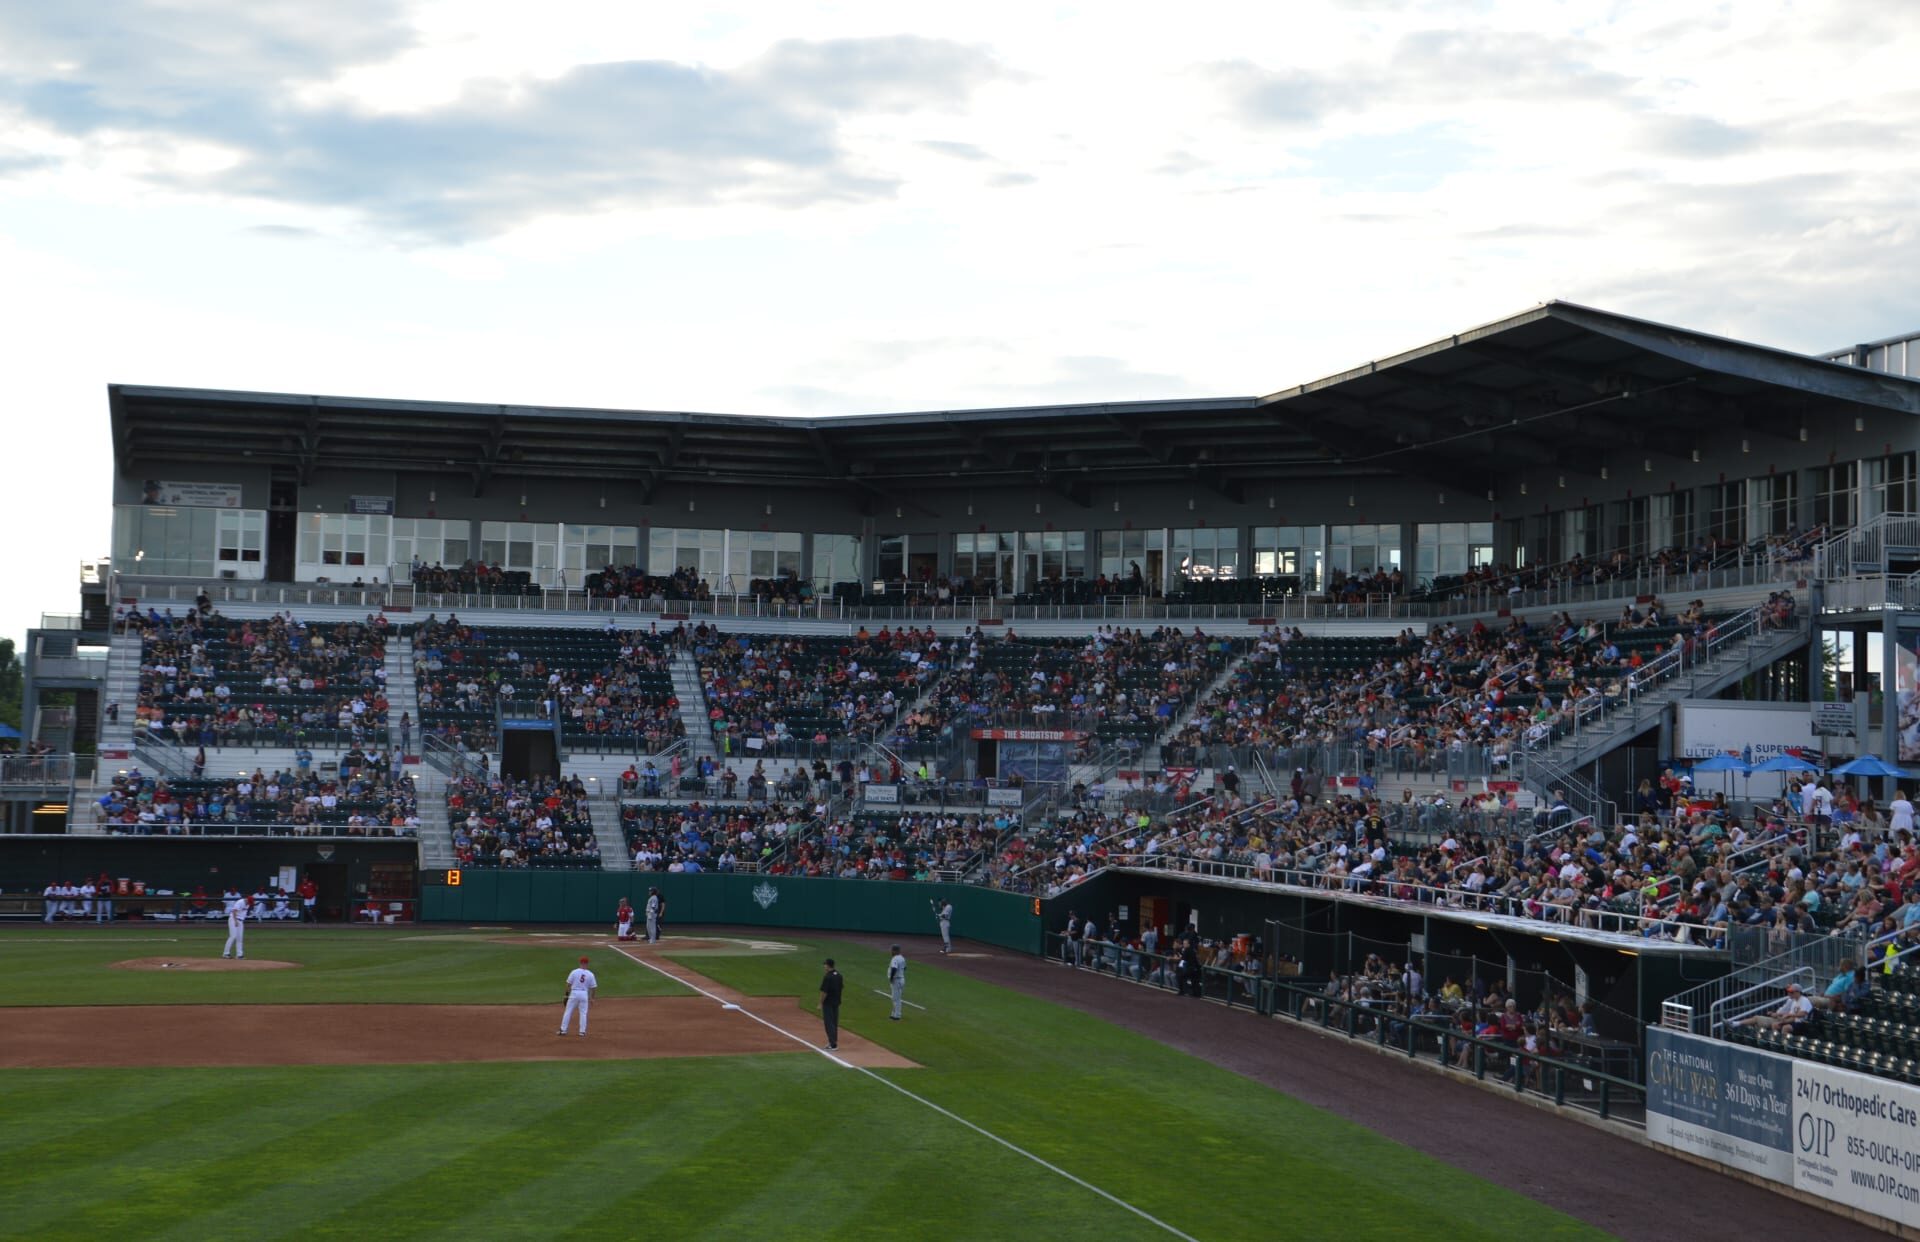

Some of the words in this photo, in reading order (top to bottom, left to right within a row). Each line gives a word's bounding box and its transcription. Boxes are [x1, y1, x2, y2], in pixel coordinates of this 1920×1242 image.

[1004, 730, 1017, 739] THE
[1020, 730, 1064, 740] SHORTSTOP
[579, 974, 586, 983] 5
[1651, 1050, 1685, 1091] CIVIL
[1690, 1072, 1718, 1100] WAR
[1663, 1048, 1677, 1063] THE
[1679, 1052, 1714, 1073] NATIONAL
[1737, 1068, 1747, 1082] We
[1757, 1073, 1773, 1091] Open
[1724, 1081, 1739, 1103] 361
[1740, 1086, 1761, 1112] Days
[1762, 1097, 1769, 1111] a
[1768, 1093, 1788, 1116] Year
[1797, 1077, 1820, 1103] 24/7
[1823, 1084, 1887, 1119] Orthopedic
[1889, 1100, 1917, 1127] Care
[1798, 1112, 1835, 1158] OIP
[1850, 1168, 1920, 1204] www.OIP.com
